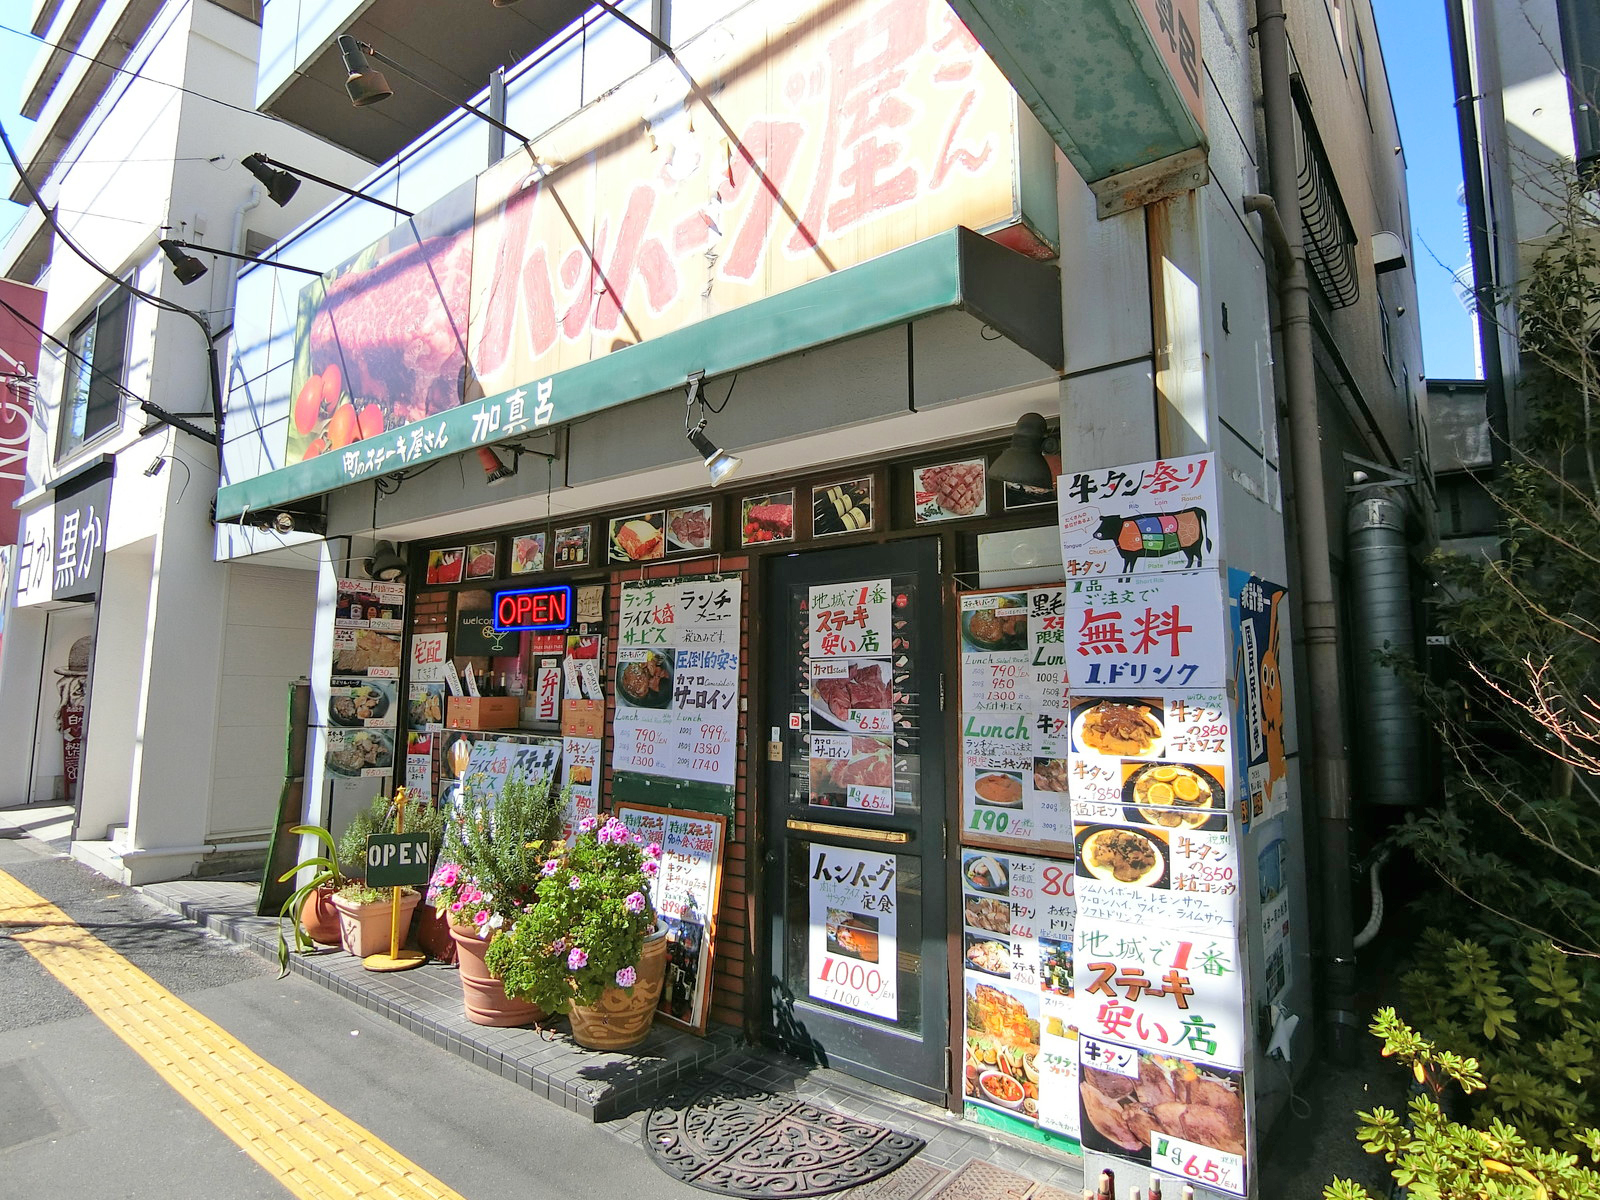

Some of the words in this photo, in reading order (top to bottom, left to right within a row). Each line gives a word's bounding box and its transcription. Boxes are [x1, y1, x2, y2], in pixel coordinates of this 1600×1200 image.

[342, 421, 449, 478] 町のステーキ屋さん
[471, 377, 555, 443] 加真呂
[1069, 459, 1208, 504] 牛タン祭り
[54, 503, 102, 591] 黒か
[1066, 559, 1107, 576] 牛タン
[1071, 579, 1103, 594] 1品
[624, 589, 656, 608] ランチ
[681, 588, 732, 610] ランチ
[1084, 587, 1159, 606] ご注文で
[499, 593, 566, 625] OPEN
[623, 603, 676, 629] ライス大盛
[694, 609, 732, 623] メニュー
[815, 605, 869, 633] ステーキ
[623, 627, 667, 646] サービス
[1036, 629, 1064, 644] 限定
[1076, 604, 1193, 657] 無料
[415, 638, 443, 664] 宅配
[821, 629, 880, 656] 安い店
[676, 649, 738, 670] 圧倒的安さ
[965, 654, 993, 665] Lunch
[1032, 646, 1066, 666] Lun
[813, 664, 833, 676] カマロ
[990, 665, 1016, 678] 790
[1036, 672, 1058, 684] 100g
[676, 674, 705, 686] カマロ
[992, 678, 1015, 689] 950
[540, 669, 558, 718] 弁当
[674, 686, 736, 710] サーロイン
[1042, 699, 1060, 709] 200g
[1170, 699, 1223, 723] 牛タン
[615, 710, 640, 721] Lunch
[676, 712, 703, 722] Lunch
[1037, 714, 1068, 734] 牛タ
[964, 715, 1030, 740] Lunch
[475, 744, 498, 757] ランチ
[566, 740, 591, 754] チキン
[635, 741, 654, 755] 950
[814, 737, 831, 745] カマロ
[1171, 735, 1226, 753] デミソース
[514, 749, 555, 771] ステーキ
[574, 755, 596, 766] ステーキ
[815, 744, 850, 758] サーロイン
[470, 757, 510, 775] ライス大盛
[1073, 760, 1115, 781] 牛タン
[968, 809, 1009, 833] 190
[368, 841, 428, 867] OPEN
[667, 848, 701, 866] サーロイン
[1176, 835, 1228, 862] 牛タン
[812, 852, 895, 891] ハンバーグ
[1011, 862, 1036, 872] ソーセージ
[1011, 885, 1033, 899] 530
[1173, 872, 1237, 896] 粒コショウ
[860, 891, 894, 914] 定食
[1011, 902, 1036, 920] 牛タン
[1011, 924, 1033, 939] 666
[1012, 944, 1024, 958] 牛
[1078, 929, 1235, 977] 地域で1番
[1012, 961, 1036, 974] ステーキ
[1085, 961, 1195, 1010] ステーキ
[1096, 999, 1218, 1056] 安い店
[1084, 1040, 1132, 1068] 牛タン
[1183, 1154, 1220, 1183] 6.5
